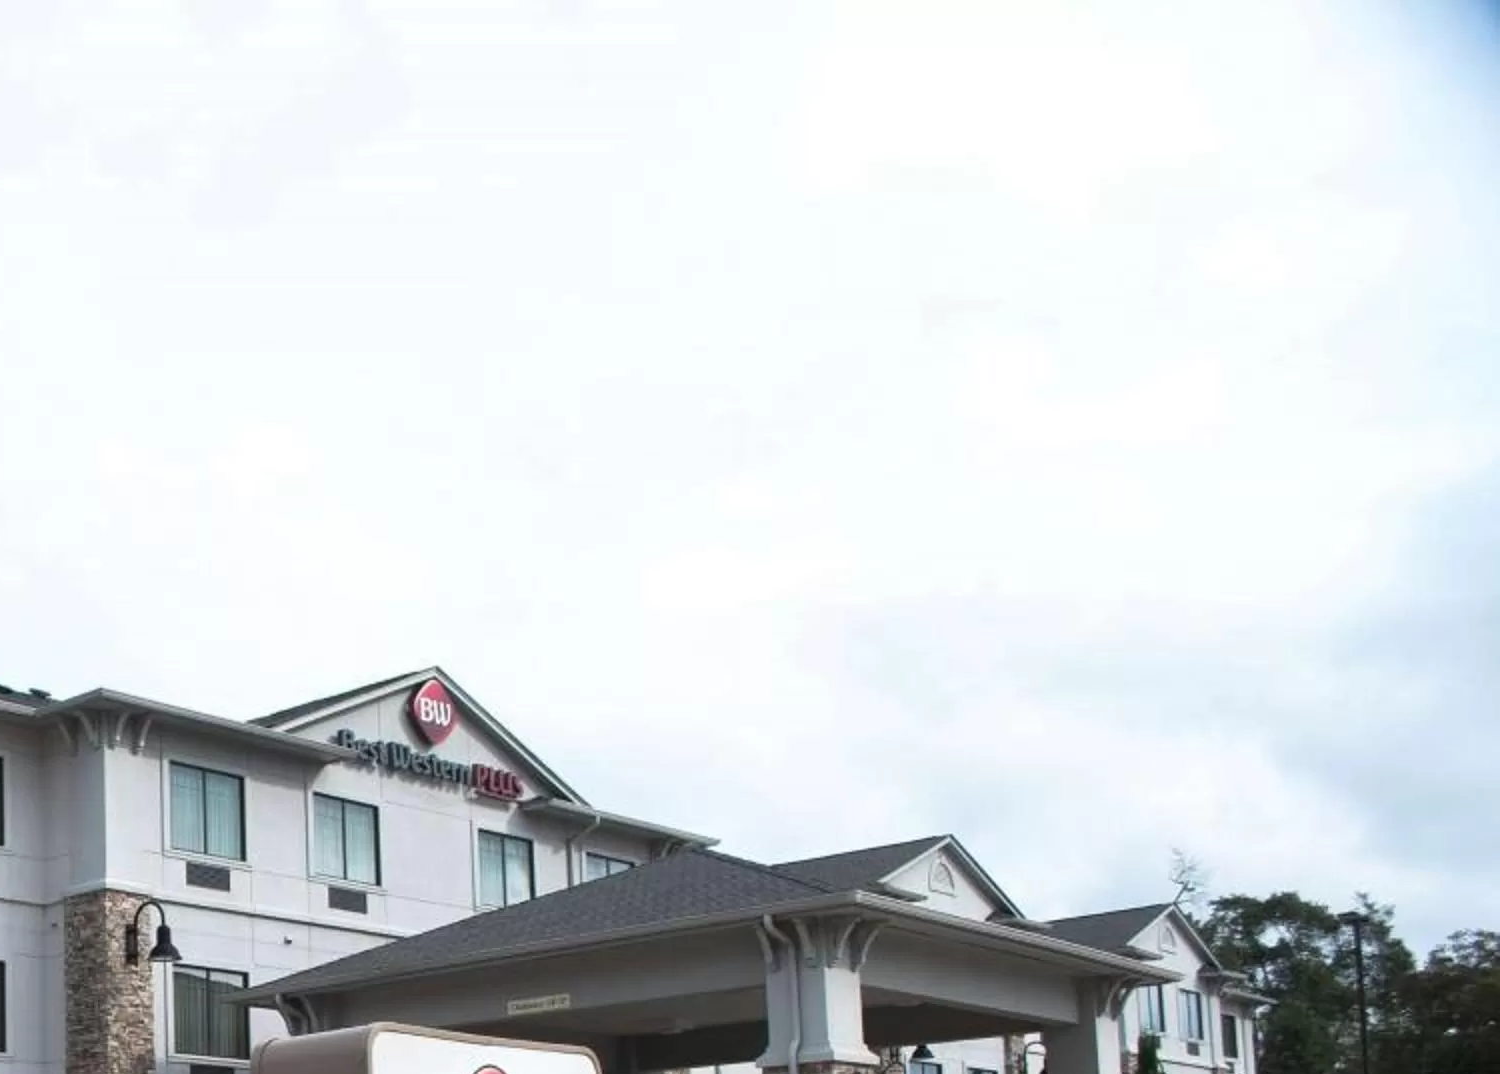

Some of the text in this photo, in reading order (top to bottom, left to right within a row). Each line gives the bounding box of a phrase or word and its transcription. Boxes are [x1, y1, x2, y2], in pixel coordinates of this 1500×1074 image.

[420, 697, 451, 726] BW
[336, 728, 524, 799] Best Western PLUS
